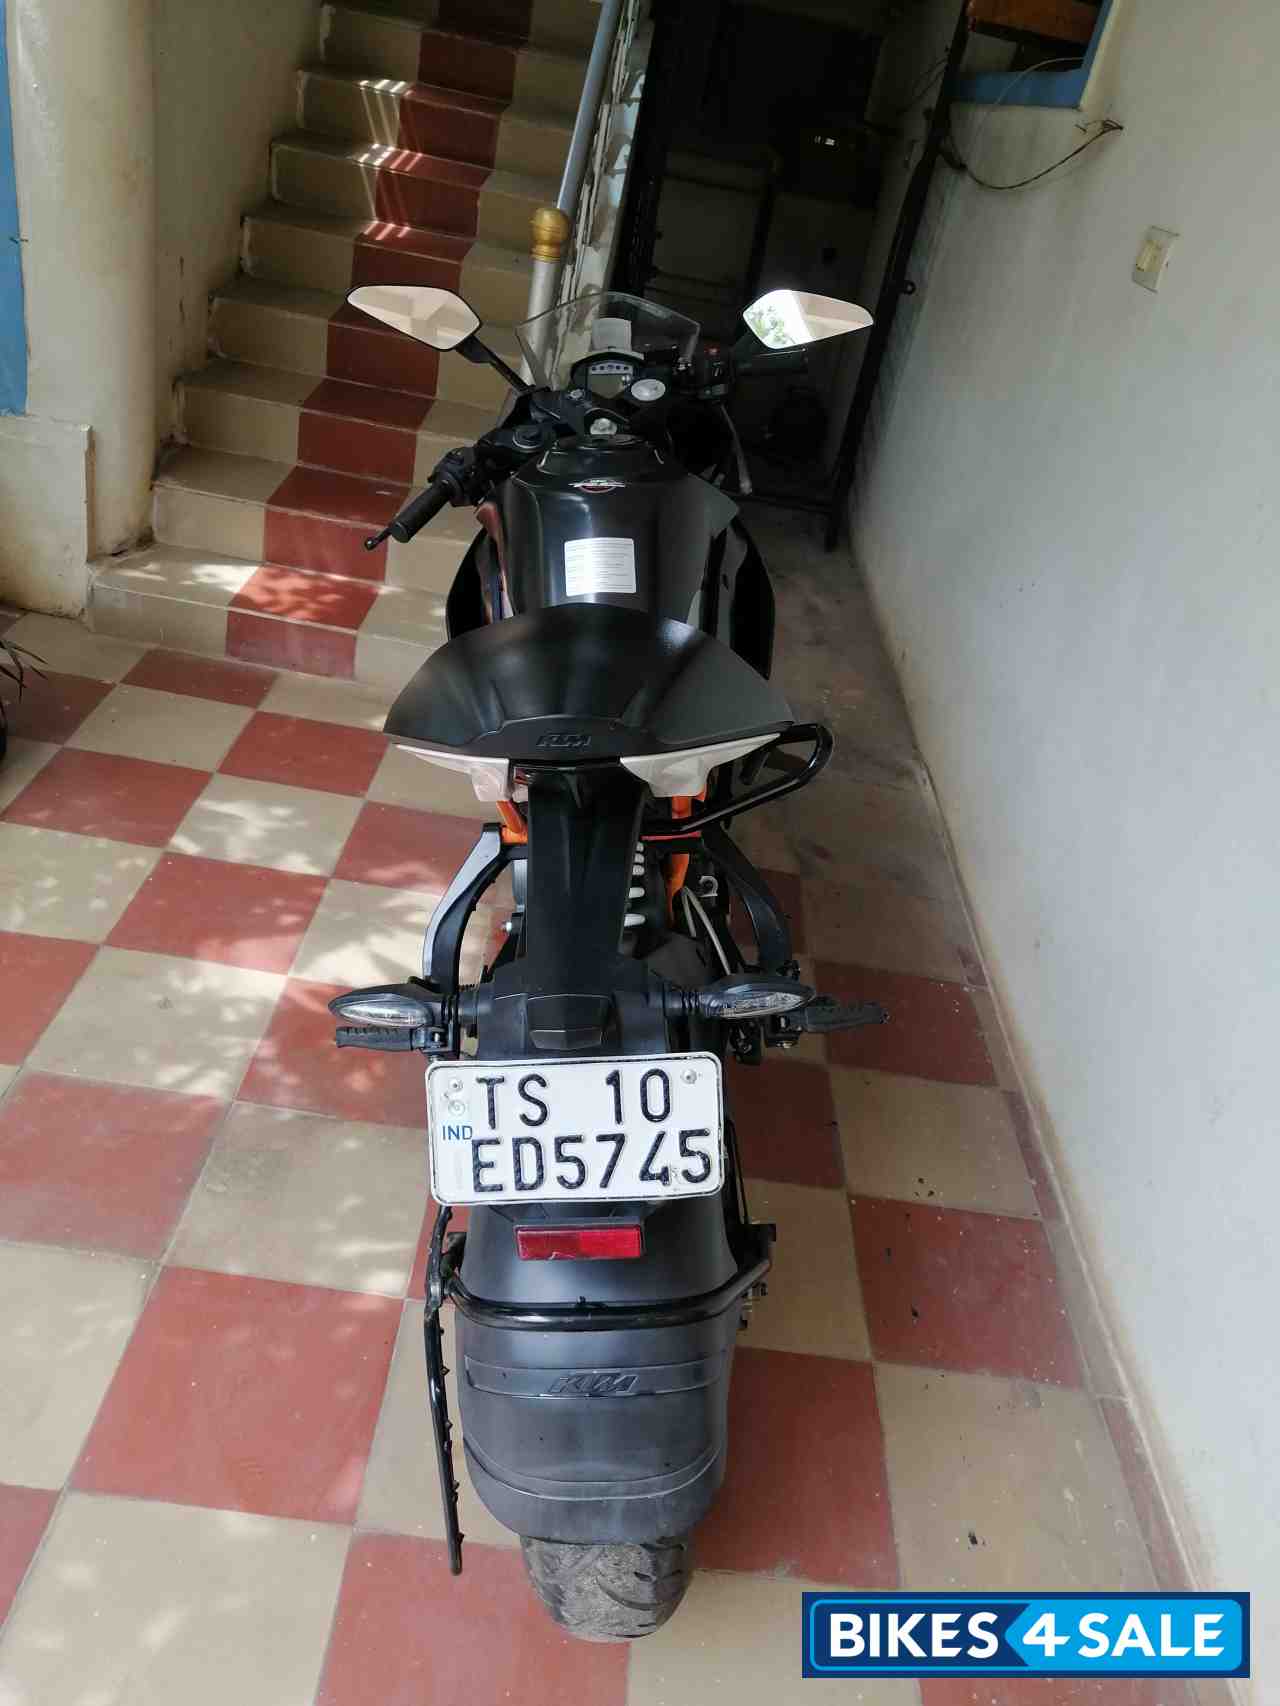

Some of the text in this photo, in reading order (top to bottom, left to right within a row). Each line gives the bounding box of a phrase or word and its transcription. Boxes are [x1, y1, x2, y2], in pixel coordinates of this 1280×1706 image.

[476, 1067, 671, 1130] TS 10
[442, 1125, 473, 1141] IND
[471, 1127, 711, 1192] ED5745
[547, 1373, 639, 1393] KTM
